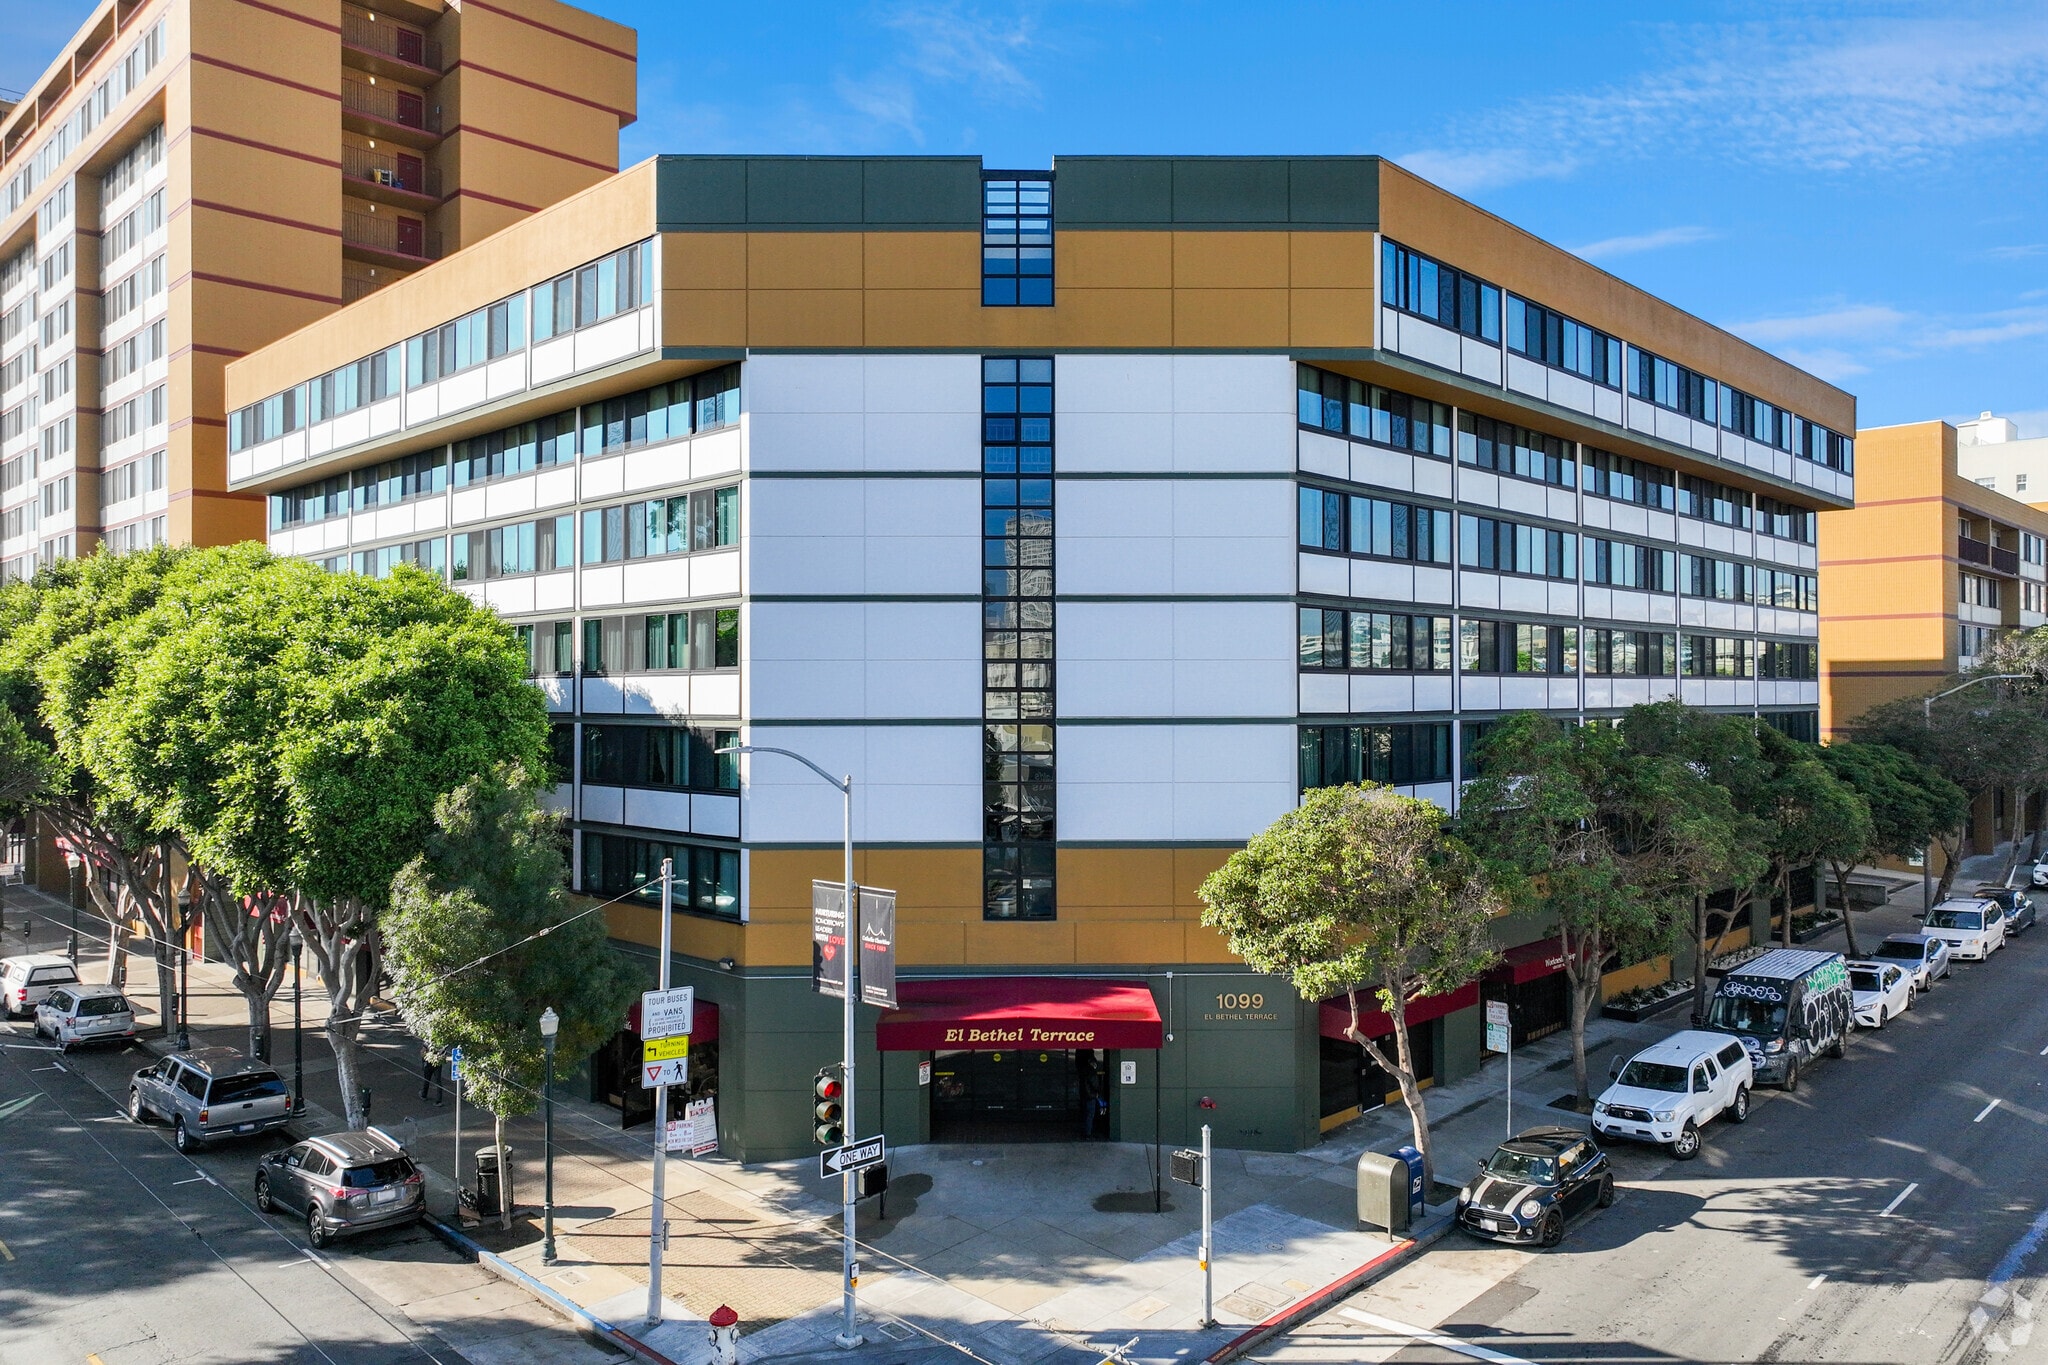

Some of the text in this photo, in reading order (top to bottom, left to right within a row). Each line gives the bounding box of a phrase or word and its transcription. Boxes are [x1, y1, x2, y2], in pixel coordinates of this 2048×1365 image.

[648, 993, 688, 1006] TOUR BUSES
[1216, 993, 1264, 1009] 1099
[663, 1007, 683, 1017] VANS
[648, 1022, 686, 1035] PROHIBITED
[945, 1028, 1095, 1042] El Bethel Terrace
[660, 1040, 685, 1048] TURNING
[658, 1048, 685, 1057] VEHICLES
[840, 1144, 878, 1165] ONE WAY
